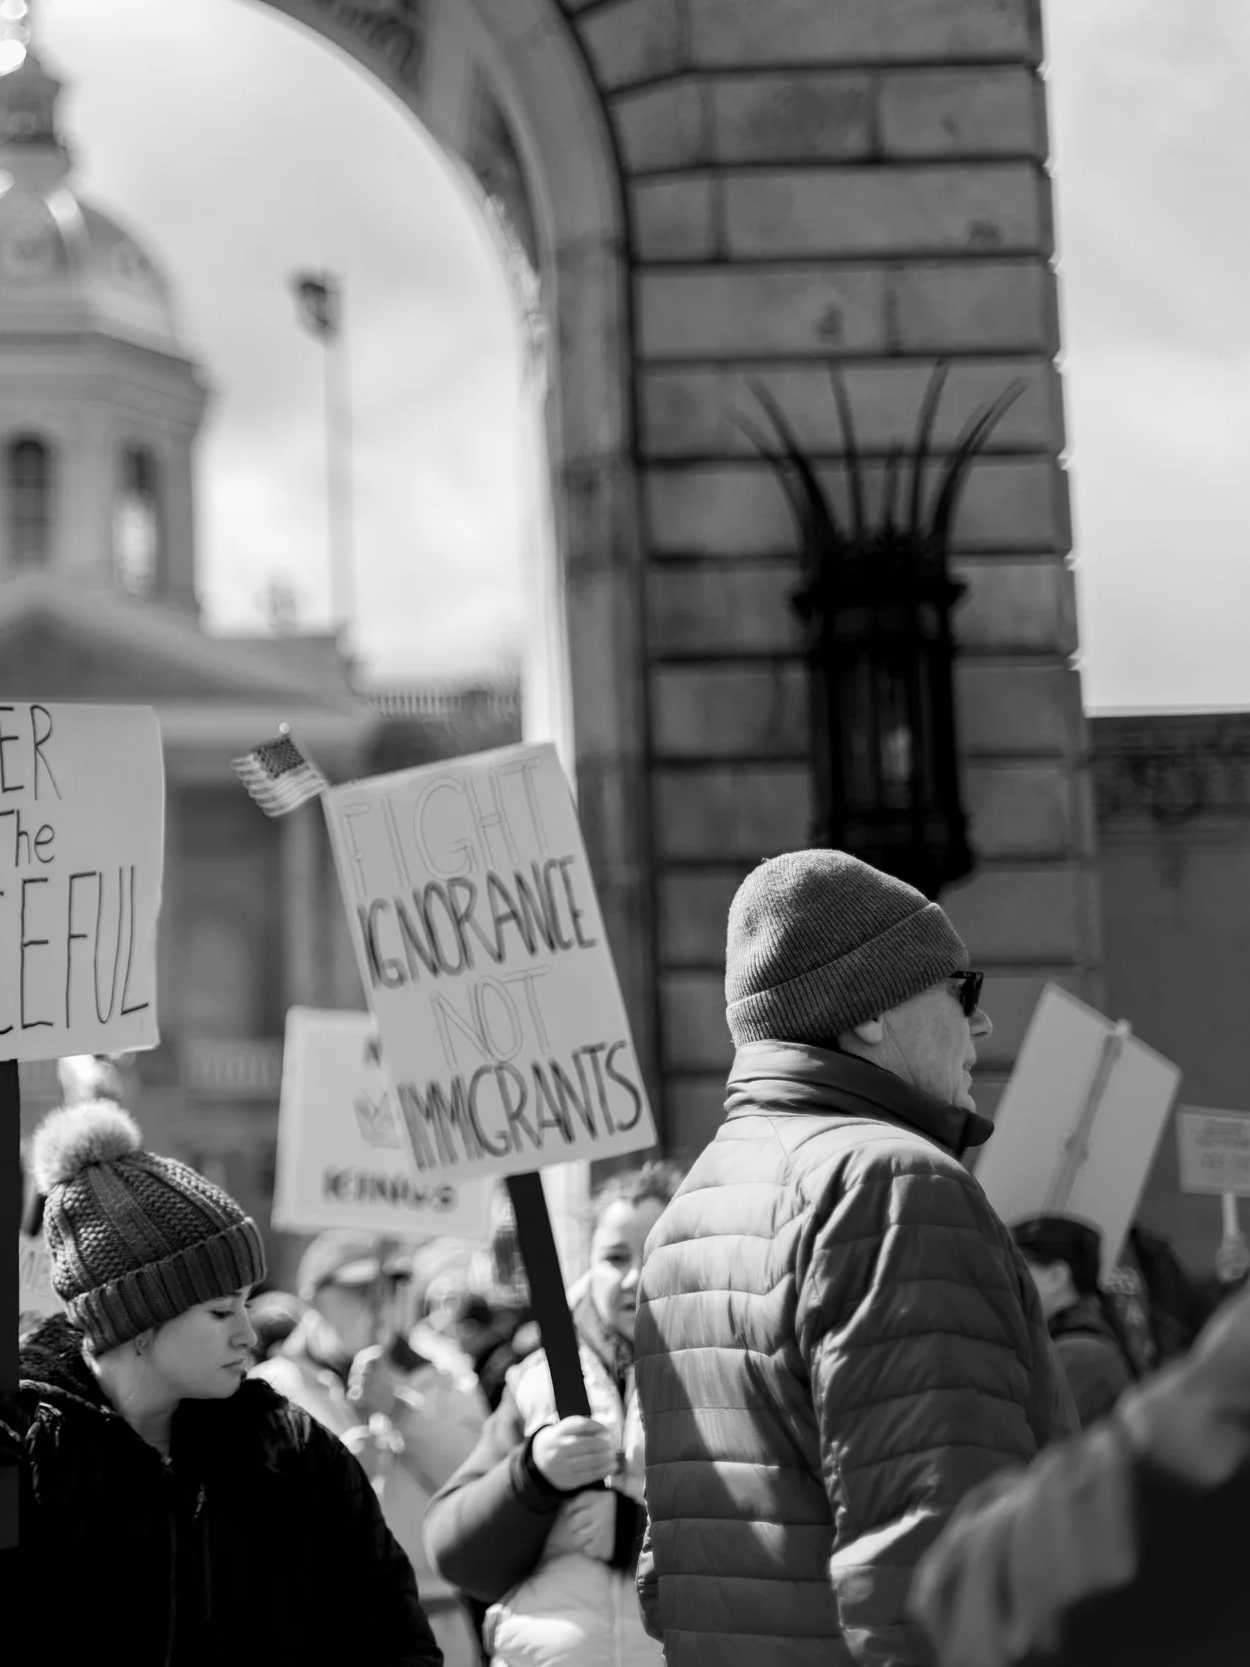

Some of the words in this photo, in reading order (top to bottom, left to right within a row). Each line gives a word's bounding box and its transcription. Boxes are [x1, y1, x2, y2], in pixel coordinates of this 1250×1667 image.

[343, 755, 549, 899] FIGHT
[356, 855, 597, 989] IGNORANCE
[429, 965, 551, 1070] NOT
